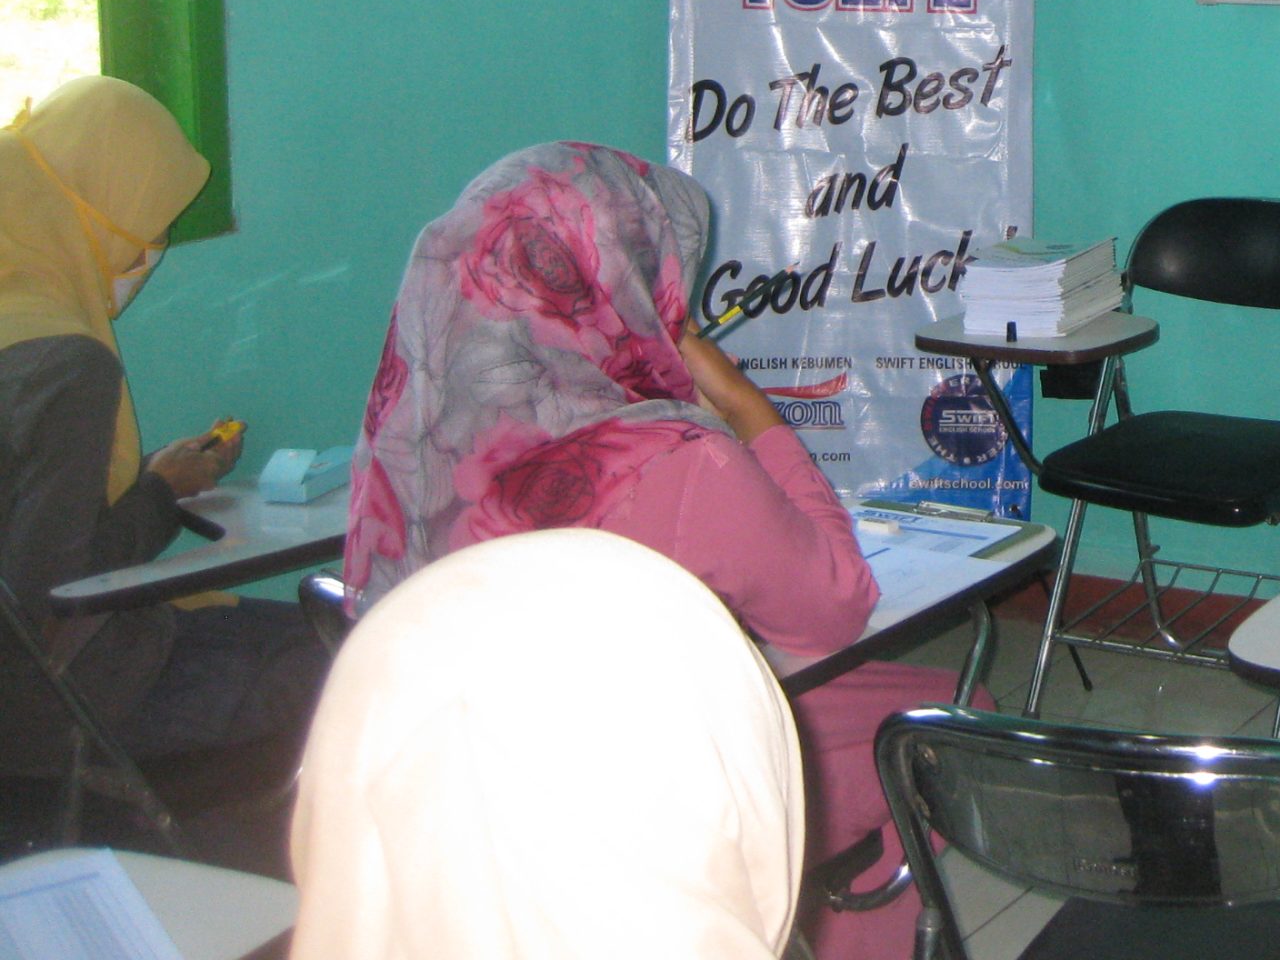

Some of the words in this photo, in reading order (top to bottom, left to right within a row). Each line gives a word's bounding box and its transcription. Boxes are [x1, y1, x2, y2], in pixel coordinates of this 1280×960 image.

[686, 78, 756, 144] Do
[768, 63, 859, 132] The
[876, 44, 1013, 120] Best
[805, 142, 910, 218] and
[701, 241, 843, 319] Good
[851, 229, 980, 303] Luck
[791, 356, 853, 370] KEBUMEN
[875, 357, 915, 370] SWIFT
[919, 357, 972, 370] ENGLISH
[939, 409, 998, 423] SWIFT
